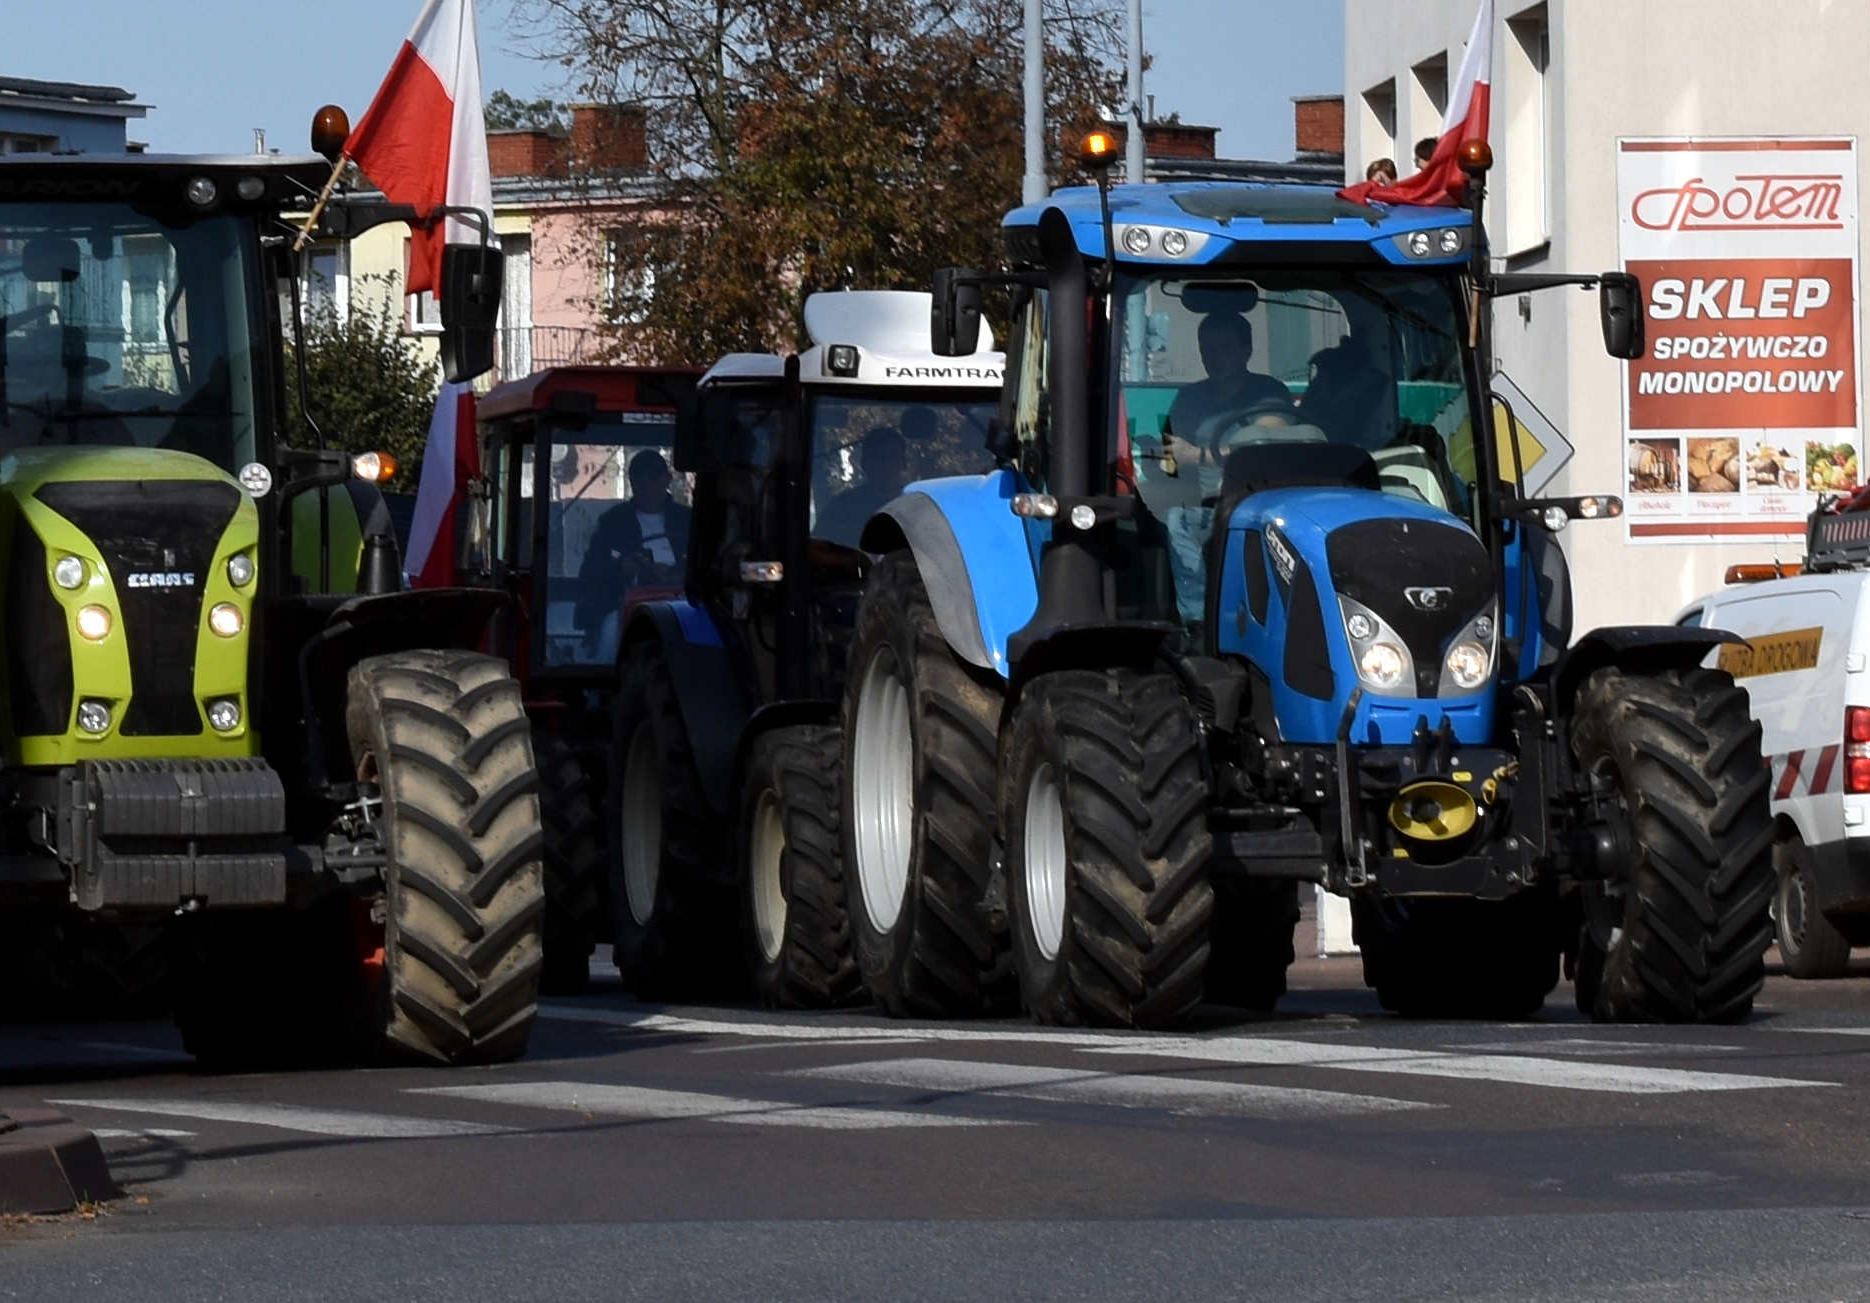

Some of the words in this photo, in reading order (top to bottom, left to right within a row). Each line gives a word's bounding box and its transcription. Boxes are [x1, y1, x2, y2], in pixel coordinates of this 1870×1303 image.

[1648, 277, 1832, 320] SKLEP
[1653, 331, 1829, 360] SPOŻYWCZO
[885, 367, 1003, 379] FARMTRA
[1638, 369, 1845, 395] MONOPOLOWY
